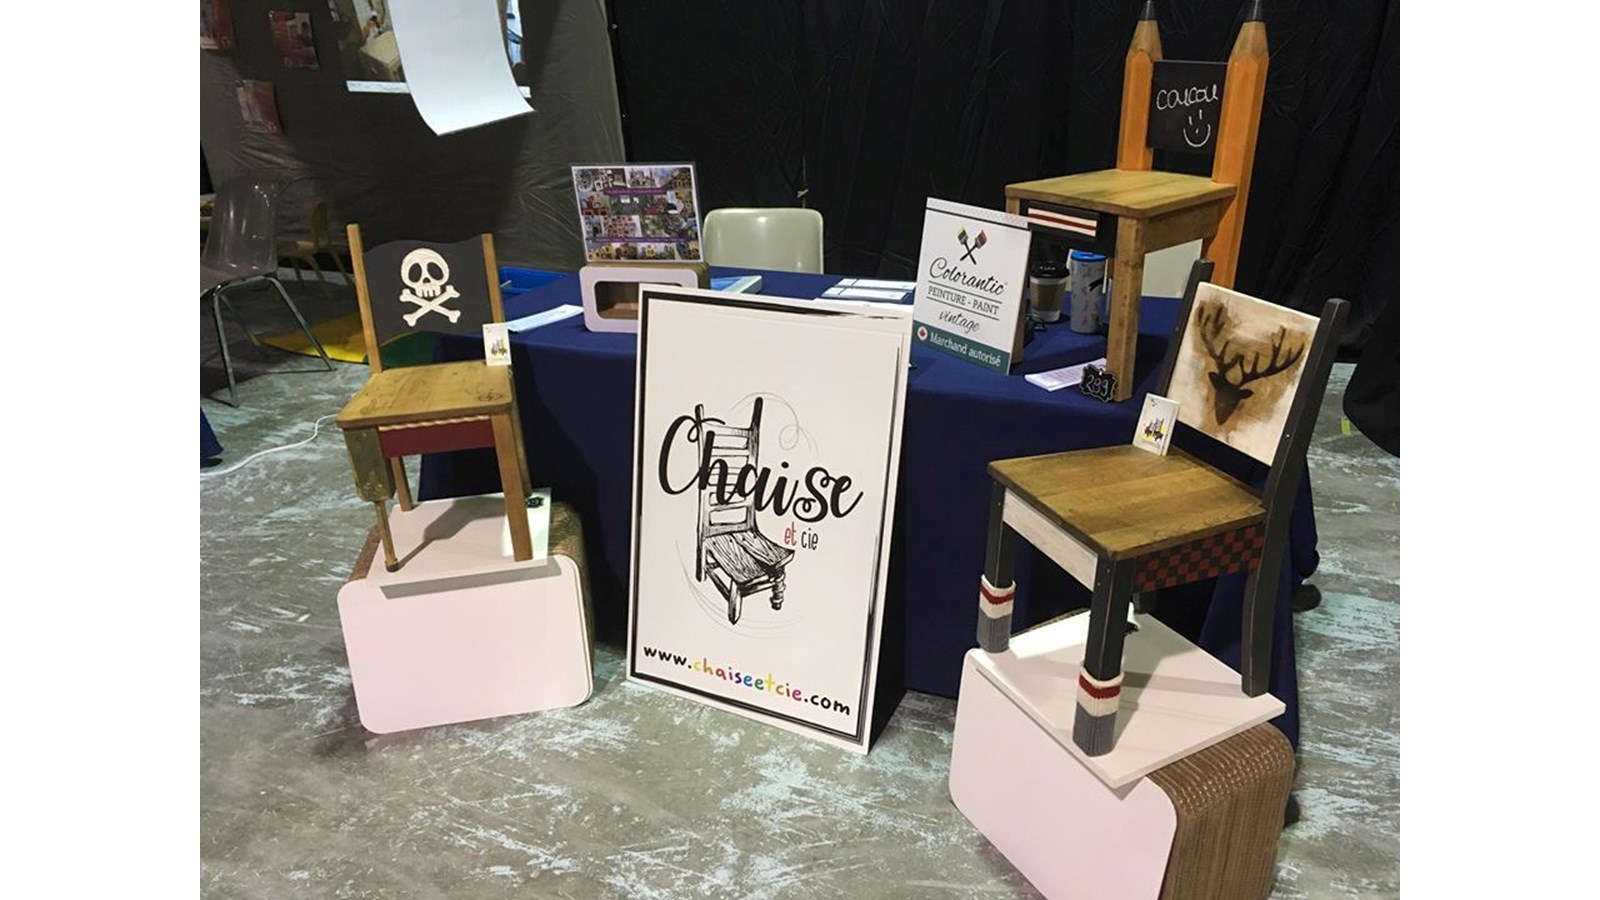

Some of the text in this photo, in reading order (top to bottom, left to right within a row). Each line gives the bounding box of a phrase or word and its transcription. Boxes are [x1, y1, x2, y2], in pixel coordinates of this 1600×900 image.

[1156, 83, 1219, 110] coucou
[929, 257, 1004, 296] Colorantic
[928, 285, 967, 306] PEINTURE
[972, 299, 1000, 316] PAINT
[938, 309, 980, 335] vintage
[930, 331, 1002, 367] Marchand autorisé
[658, 414, 864, 523] Chaise
[784, 522, 819, 551] et cie
[643, 644, 851, 716] www.chaiseetcie.com
